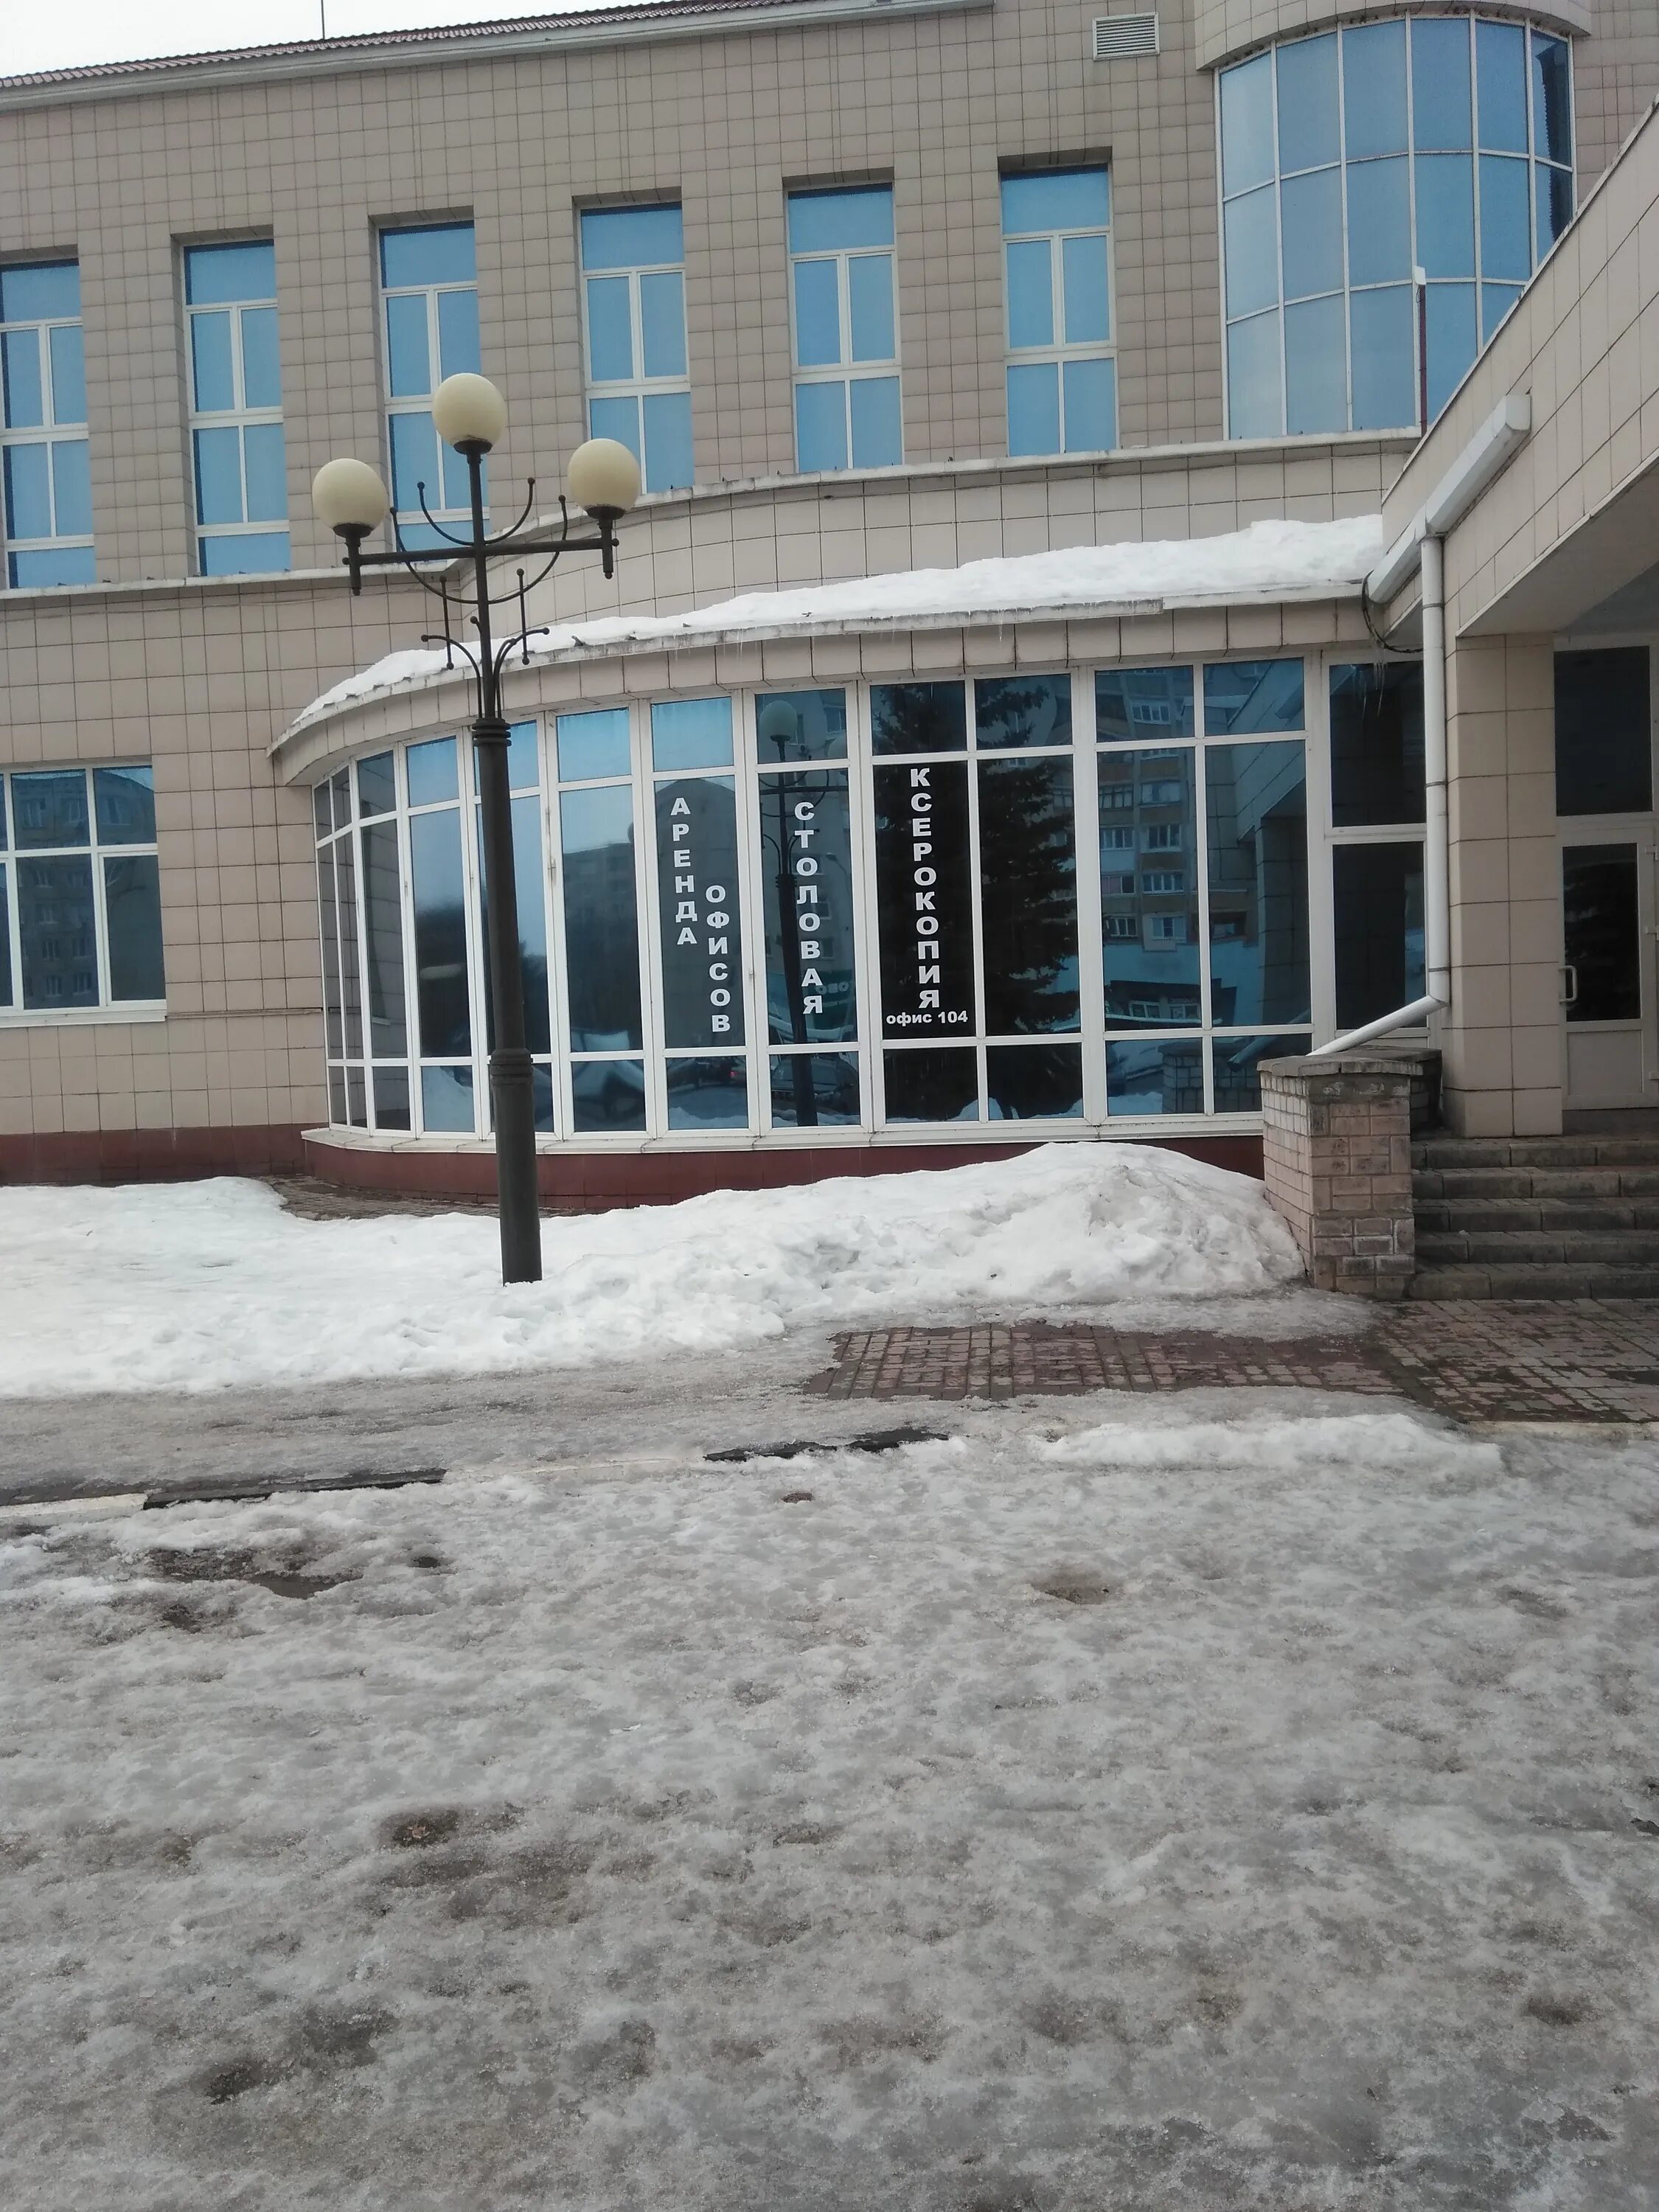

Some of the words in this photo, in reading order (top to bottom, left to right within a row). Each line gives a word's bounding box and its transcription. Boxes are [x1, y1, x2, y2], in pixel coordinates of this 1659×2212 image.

[669, 797, 698, 946] АРЕНДА
[794, 801, 824, 1015] СТОЛОВАЯ
[910, 768, 940, 1009] КСЕРОКОПИЯ
[705, 885, 731, 1032] ОФИСОВ
[886, 1012, 933, 1027] офис
[937, 1010, 969, 1025] 104
